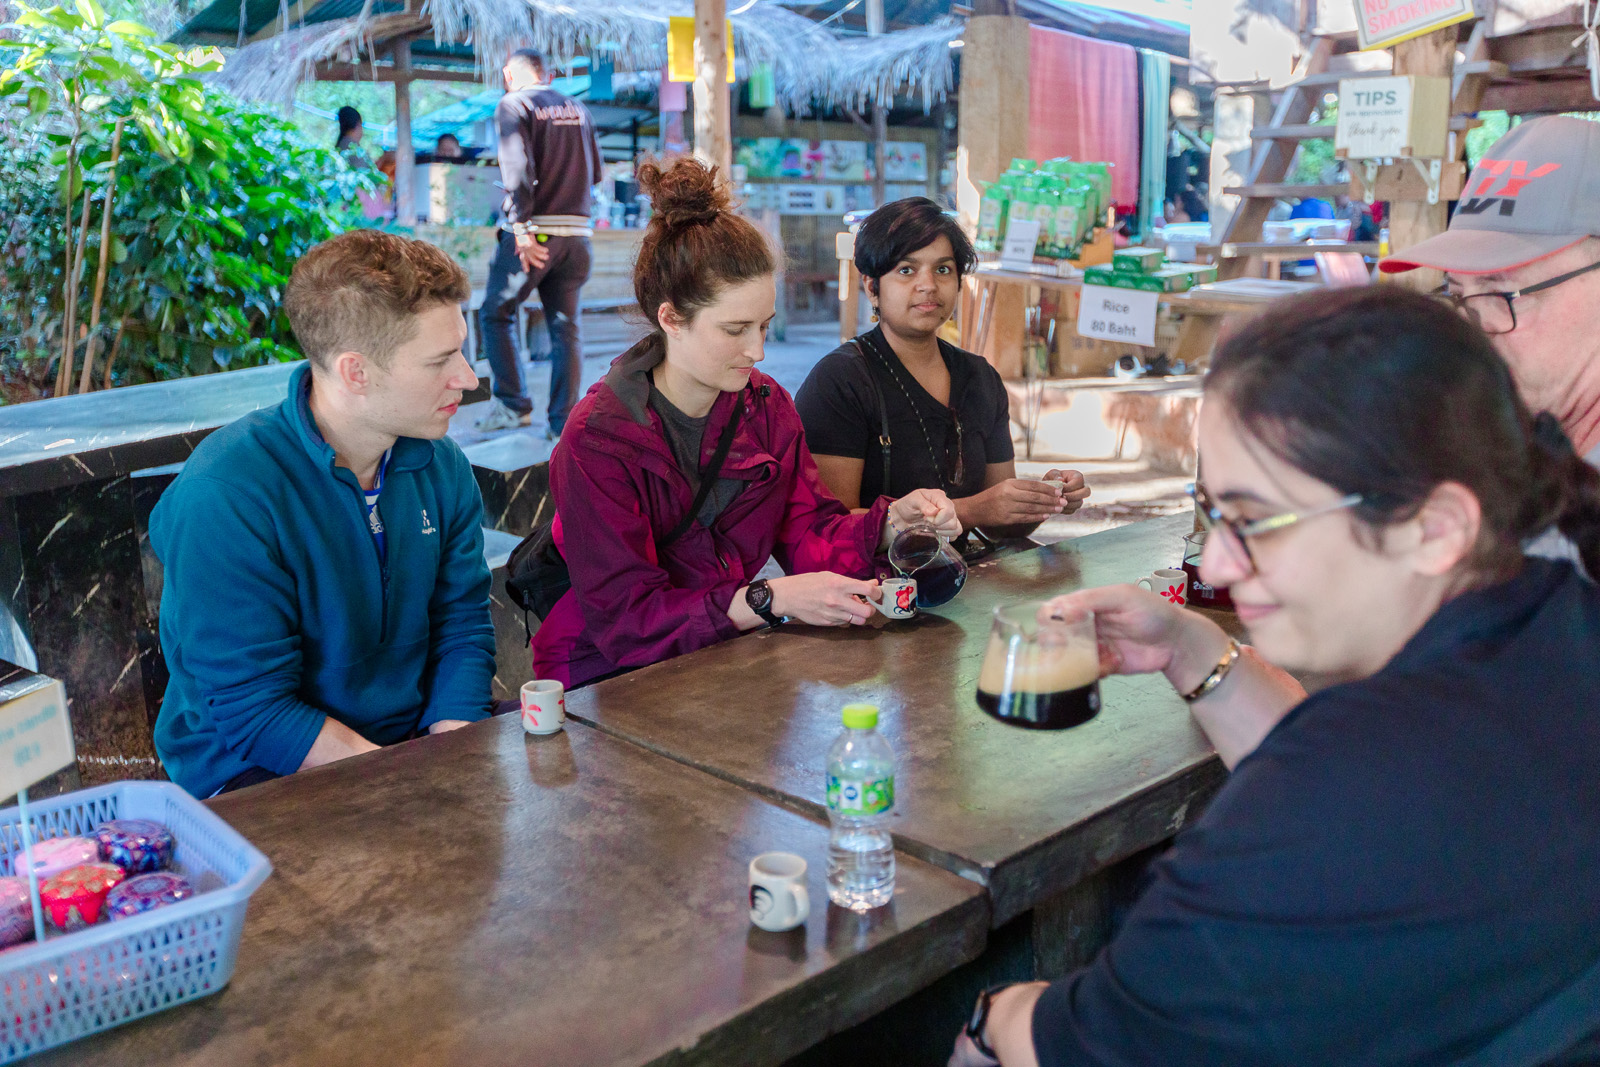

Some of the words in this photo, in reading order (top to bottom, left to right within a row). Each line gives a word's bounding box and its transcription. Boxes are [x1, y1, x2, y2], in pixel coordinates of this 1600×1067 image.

[1353, 90, 1397, 106] TIPS
[1102, 299, 1129, 314] Rice
[1091, 320, 1106, 333] 80
[1109, 321, 1136, 337] Baht
